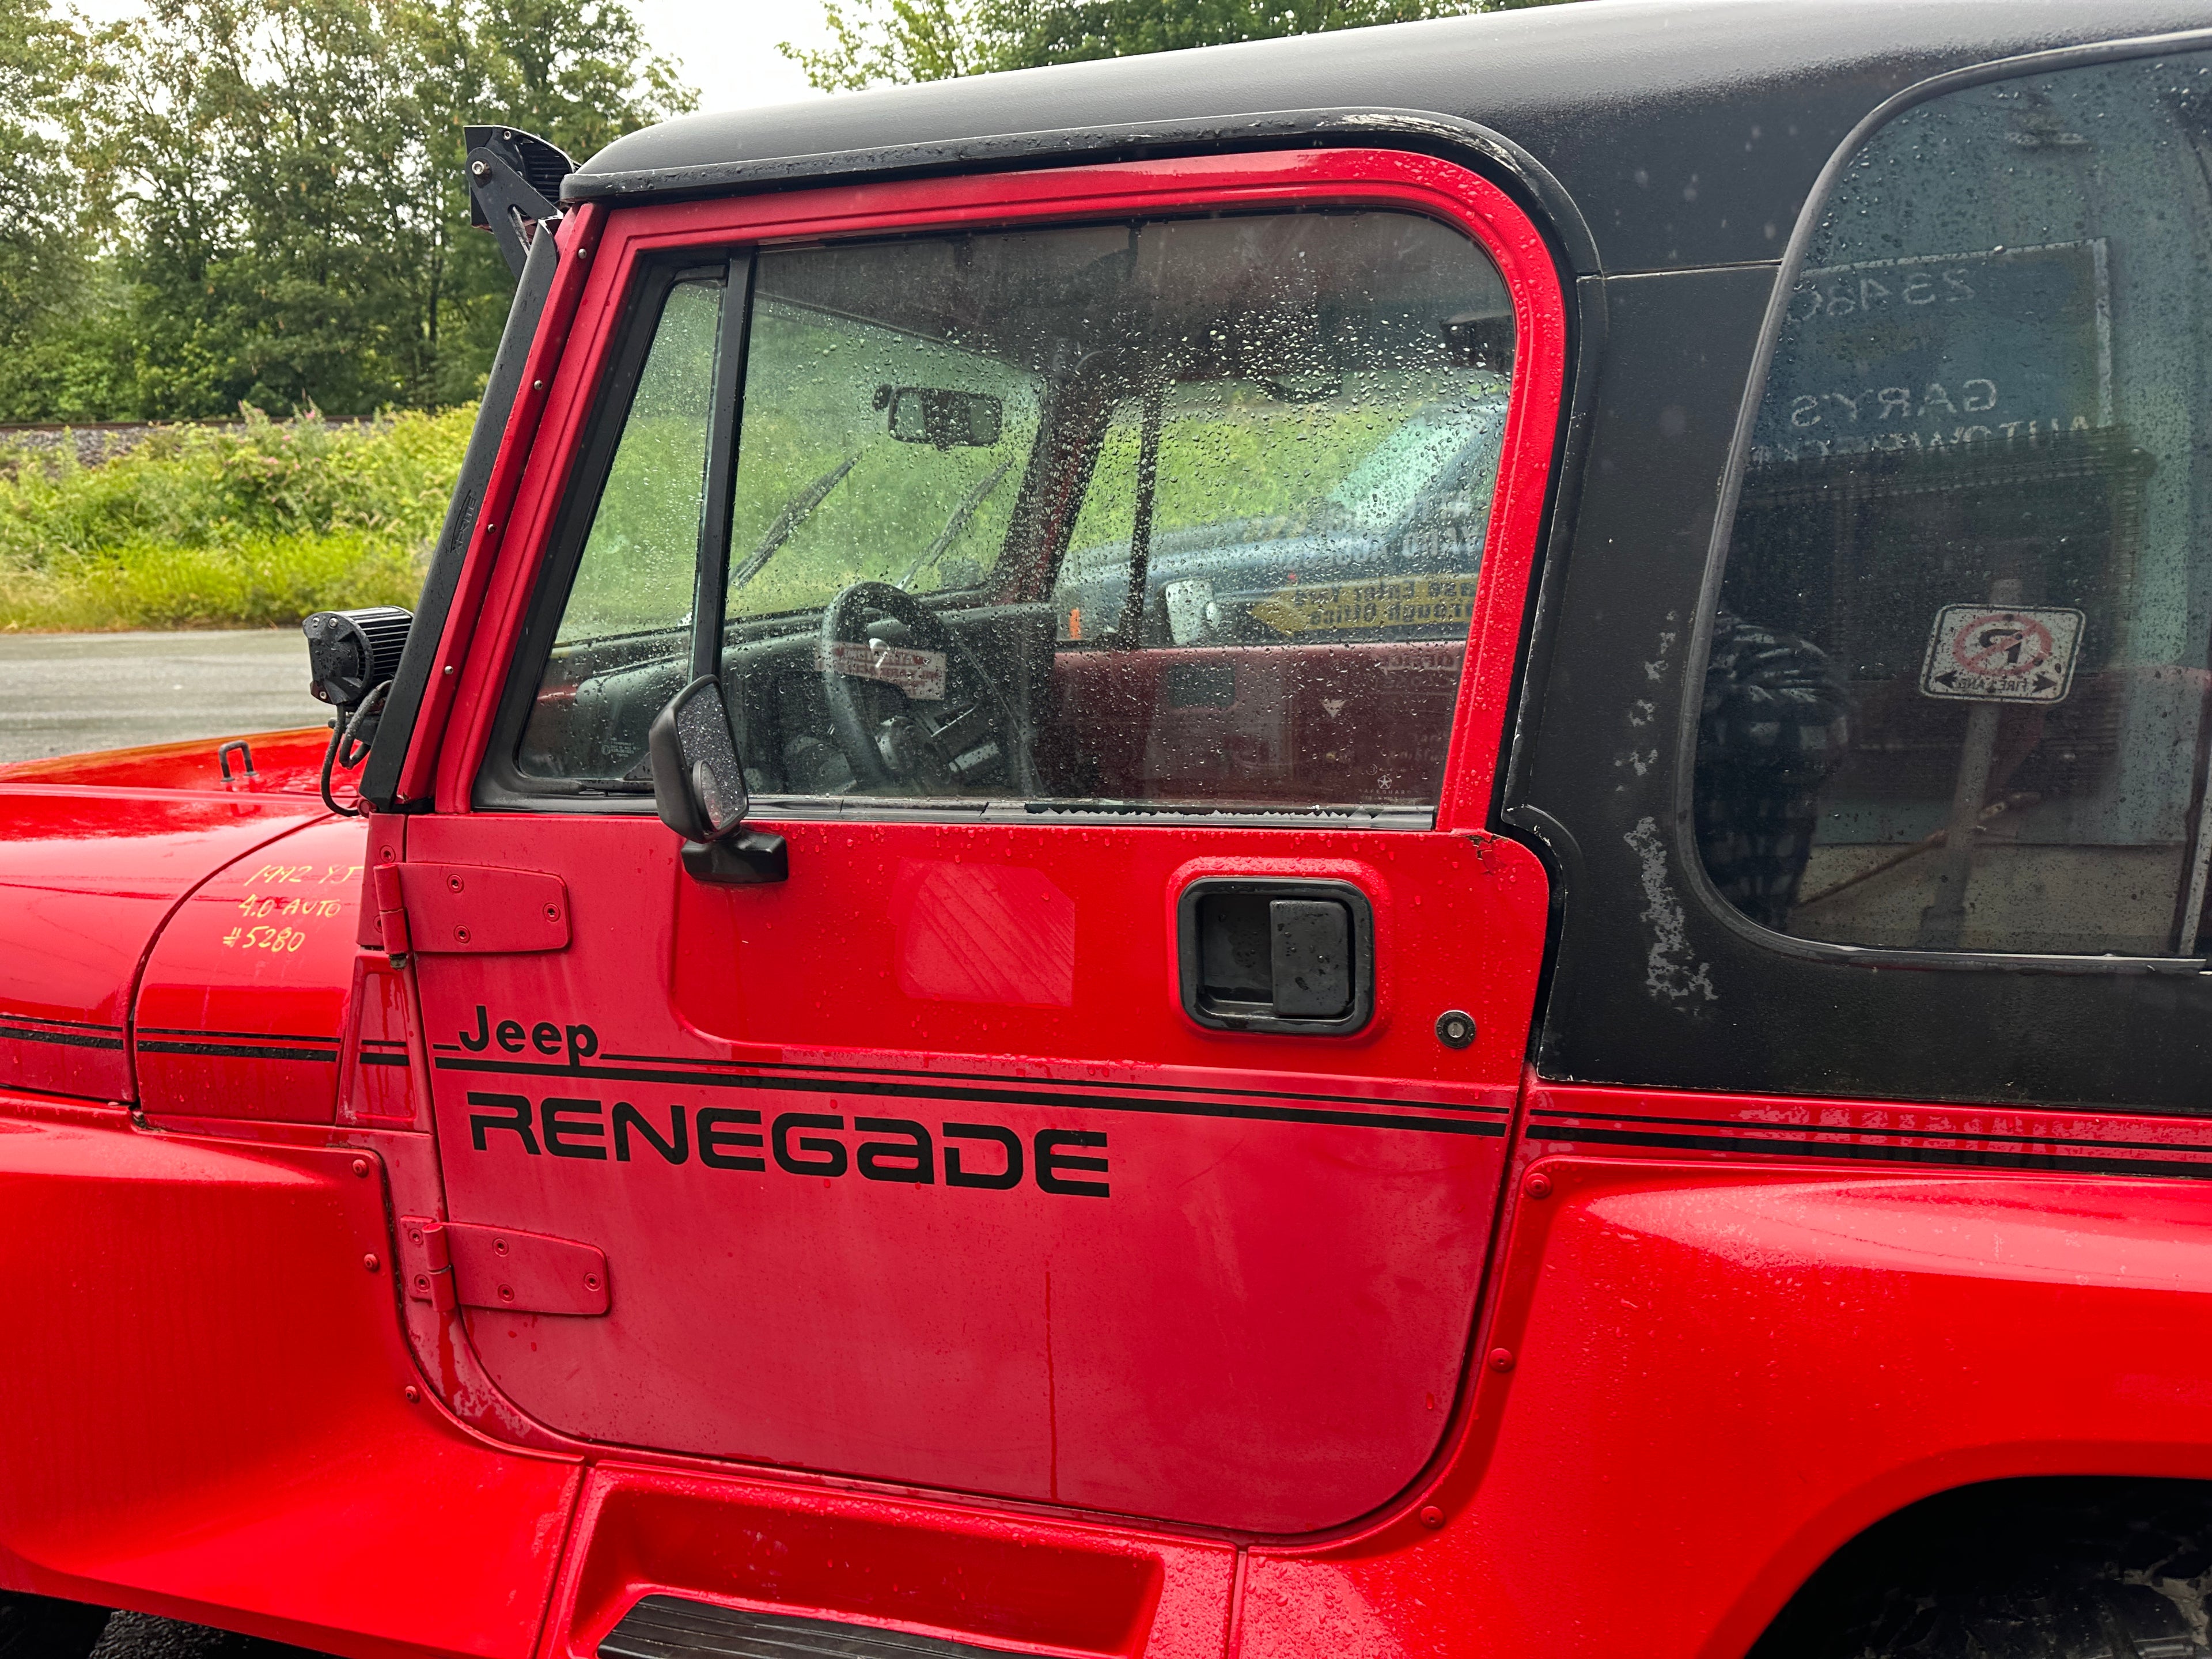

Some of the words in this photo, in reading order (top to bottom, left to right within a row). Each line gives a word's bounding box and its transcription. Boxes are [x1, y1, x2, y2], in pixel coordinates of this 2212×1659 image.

[238, 893, 275, 918] 4.0
[282, 898, 341, 918] AUTO
[223, 925, 305, 952] #5280
[459, 1005, 599, 1067] Jeep
[467, 1090, 1111, 1198] RENEGADE
